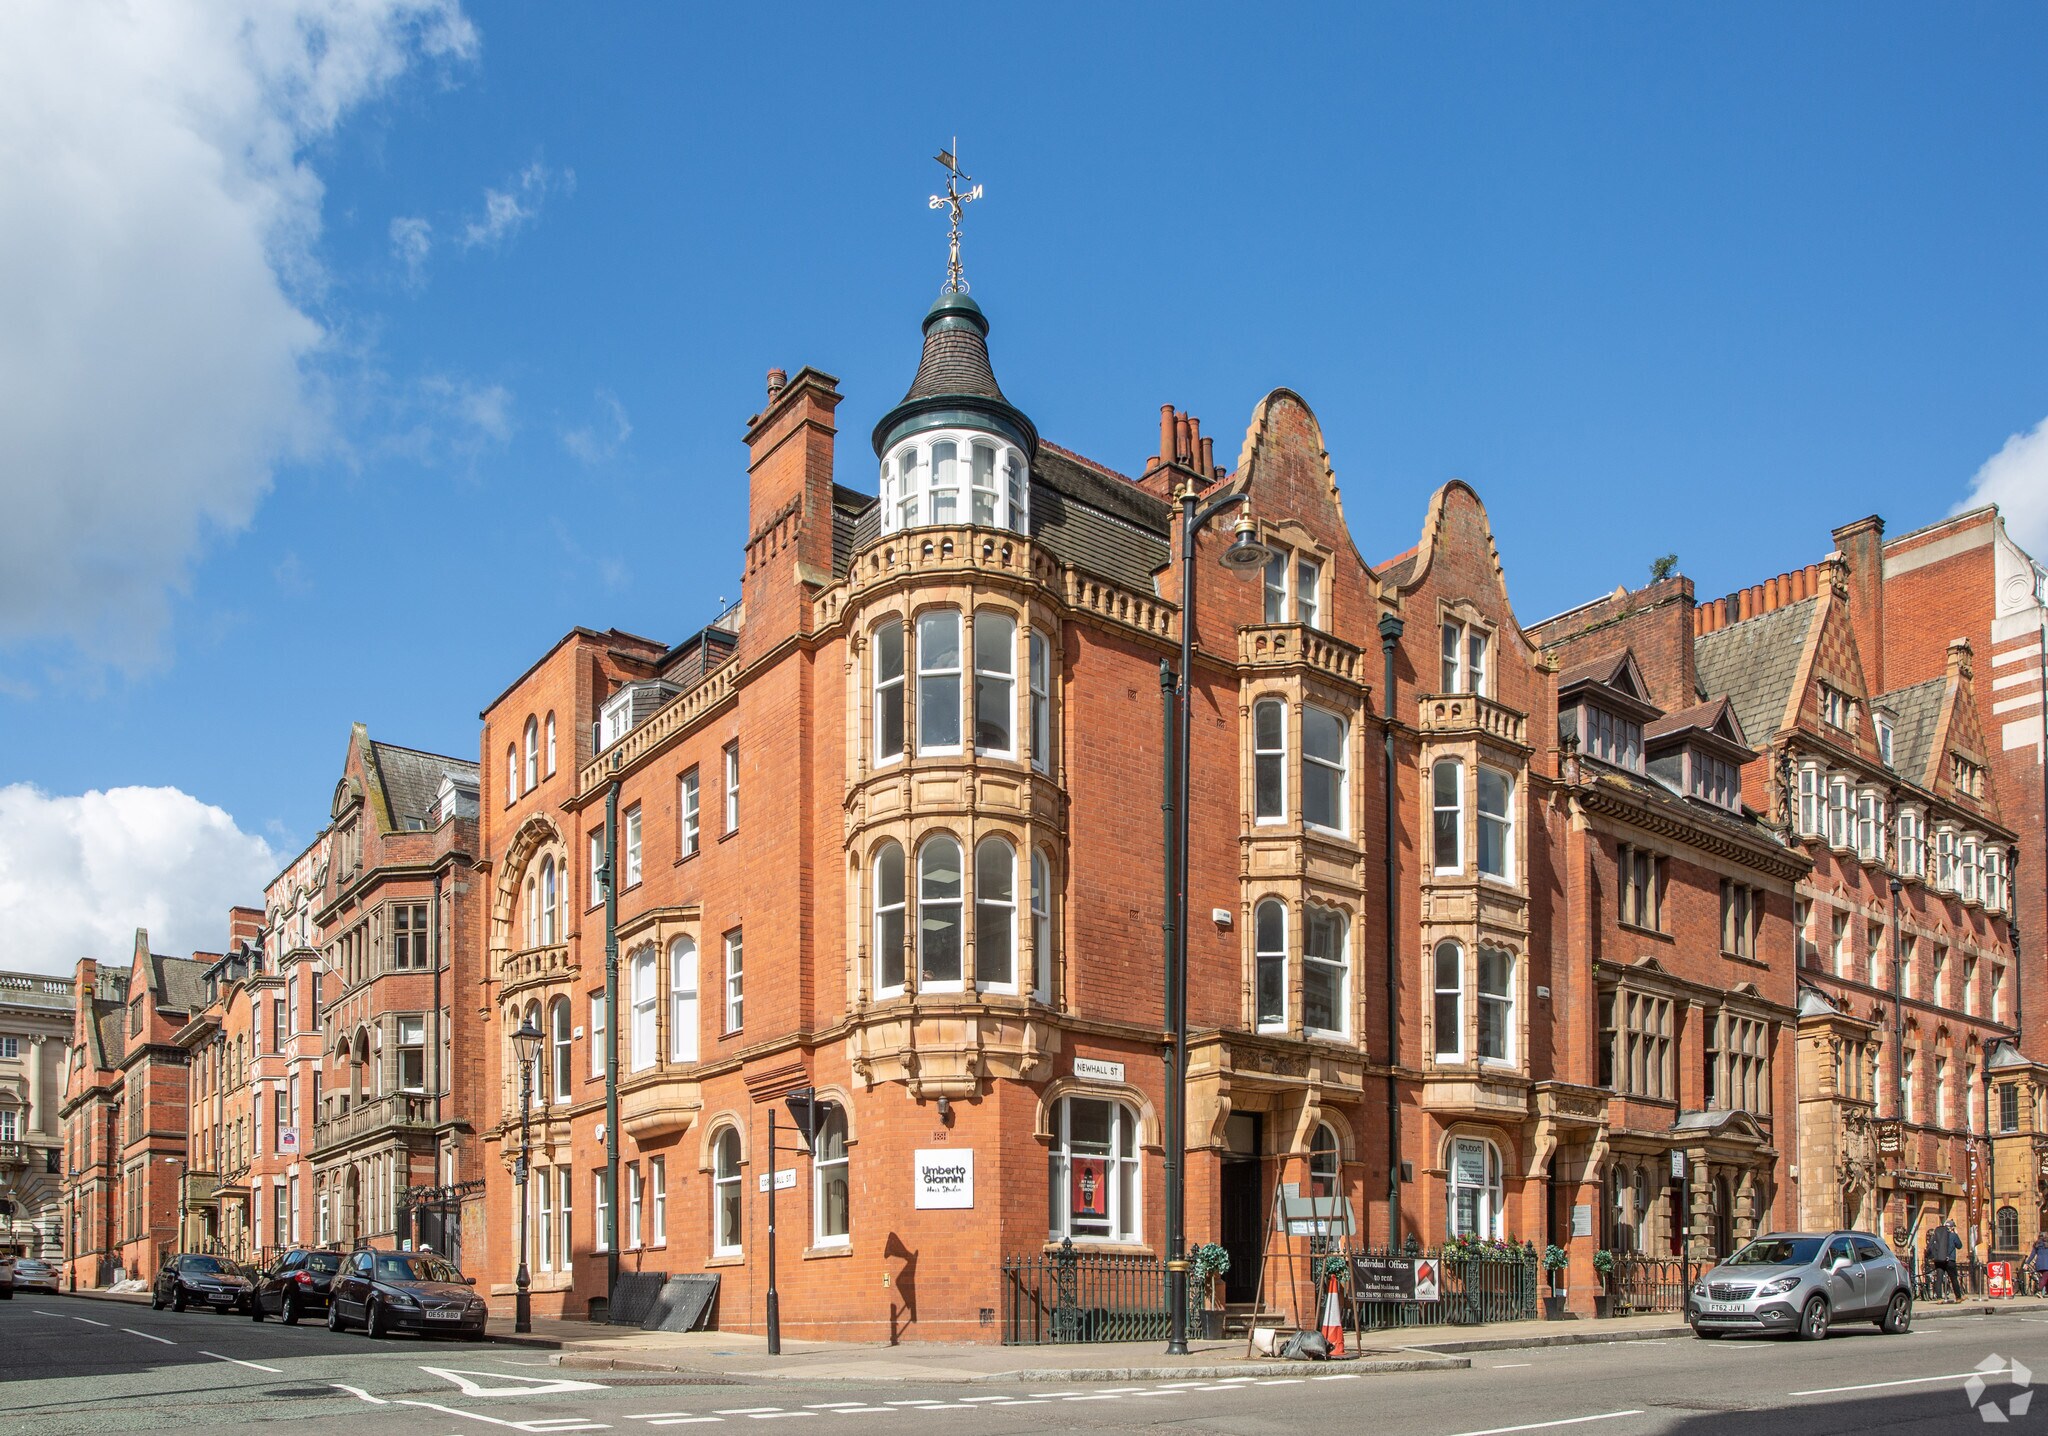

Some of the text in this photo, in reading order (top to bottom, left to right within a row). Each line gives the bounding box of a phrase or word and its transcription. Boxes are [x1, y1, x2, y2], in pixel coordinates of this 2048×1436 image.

[1077, 1063, 1107, 1074] NEWHALL
[1110, 1067, 1118, 1076] ST
[922, 1165, 966, 1175] Umberto
[924, 1174, 964, 1184] Giannini
[1910, 1180, 1924, 1189] COFFEE
[1925, 1182, 1938, 1190] HOUSE
[1358, 1258, 1408, 1269] Individual Offices
